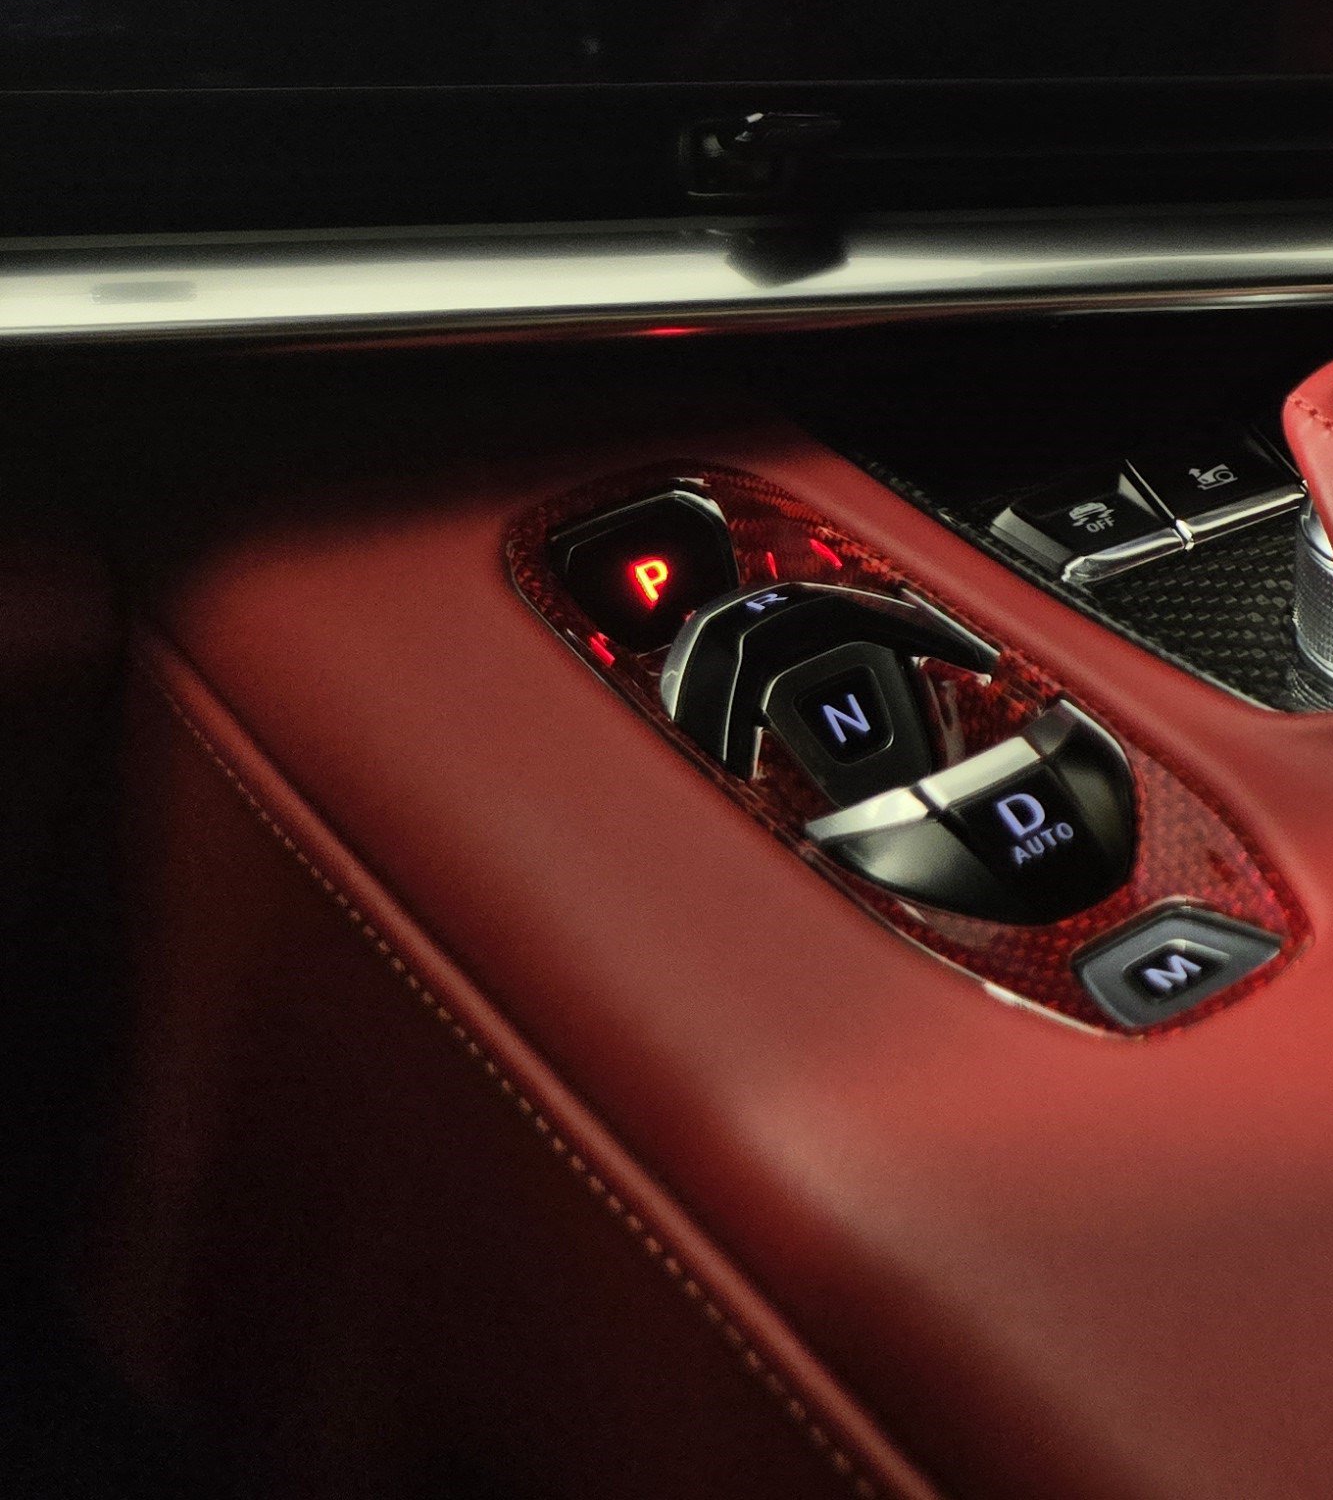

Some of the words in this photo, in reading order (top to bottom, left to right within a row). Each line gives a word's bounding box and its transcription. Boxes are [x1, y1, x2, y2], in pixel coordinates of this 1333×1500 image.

[1085, 514, 1116, 535] OFF
[633, 556, 669, 607] P
[744, 590, 788, 611] R
[821, 692, 873, 745] N
[996, 791, 1046, 839] D
[1011, 821, 1074, 866] AUTO
[1143, 955, 1200, 992] M
